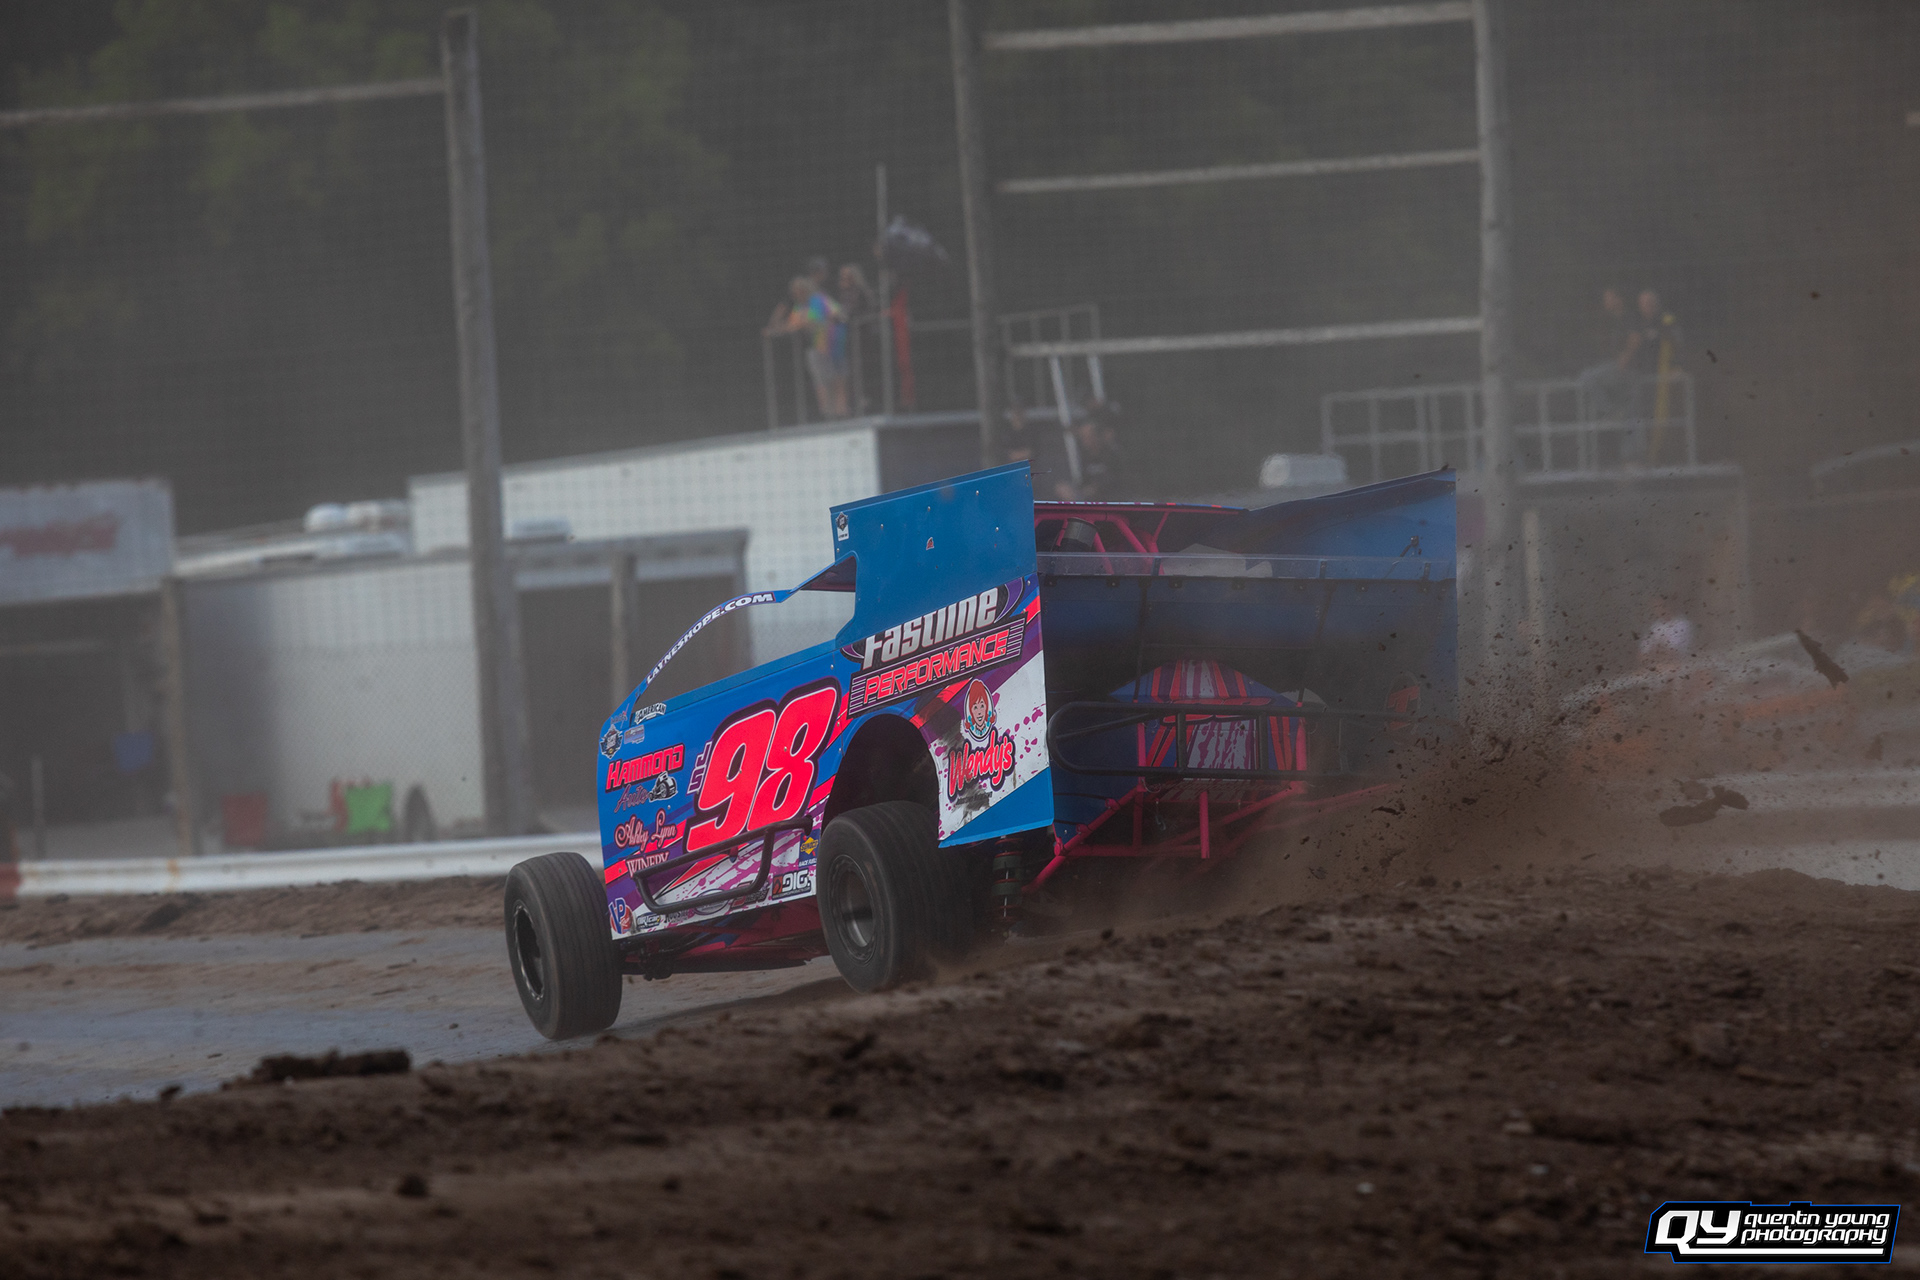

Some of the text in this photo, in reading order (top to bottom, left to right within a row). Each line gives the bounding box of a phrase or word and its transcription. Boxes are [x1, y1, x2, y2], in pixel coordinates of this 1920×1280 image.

[646, 593, 773, 684] LAYNESHOPE.COM
[864, 629, 1010, 704] PERFORMANCE
[606, 745, 684, 790] HAMMOND
[687, 687, 836, 853] 98
[949, 730, 1013, 796] Wendy's
[614, 784, 648, 813] Auto
[615, 808, 676, 851] Ashley Lynn
[608, 898, 626, 934] VP
